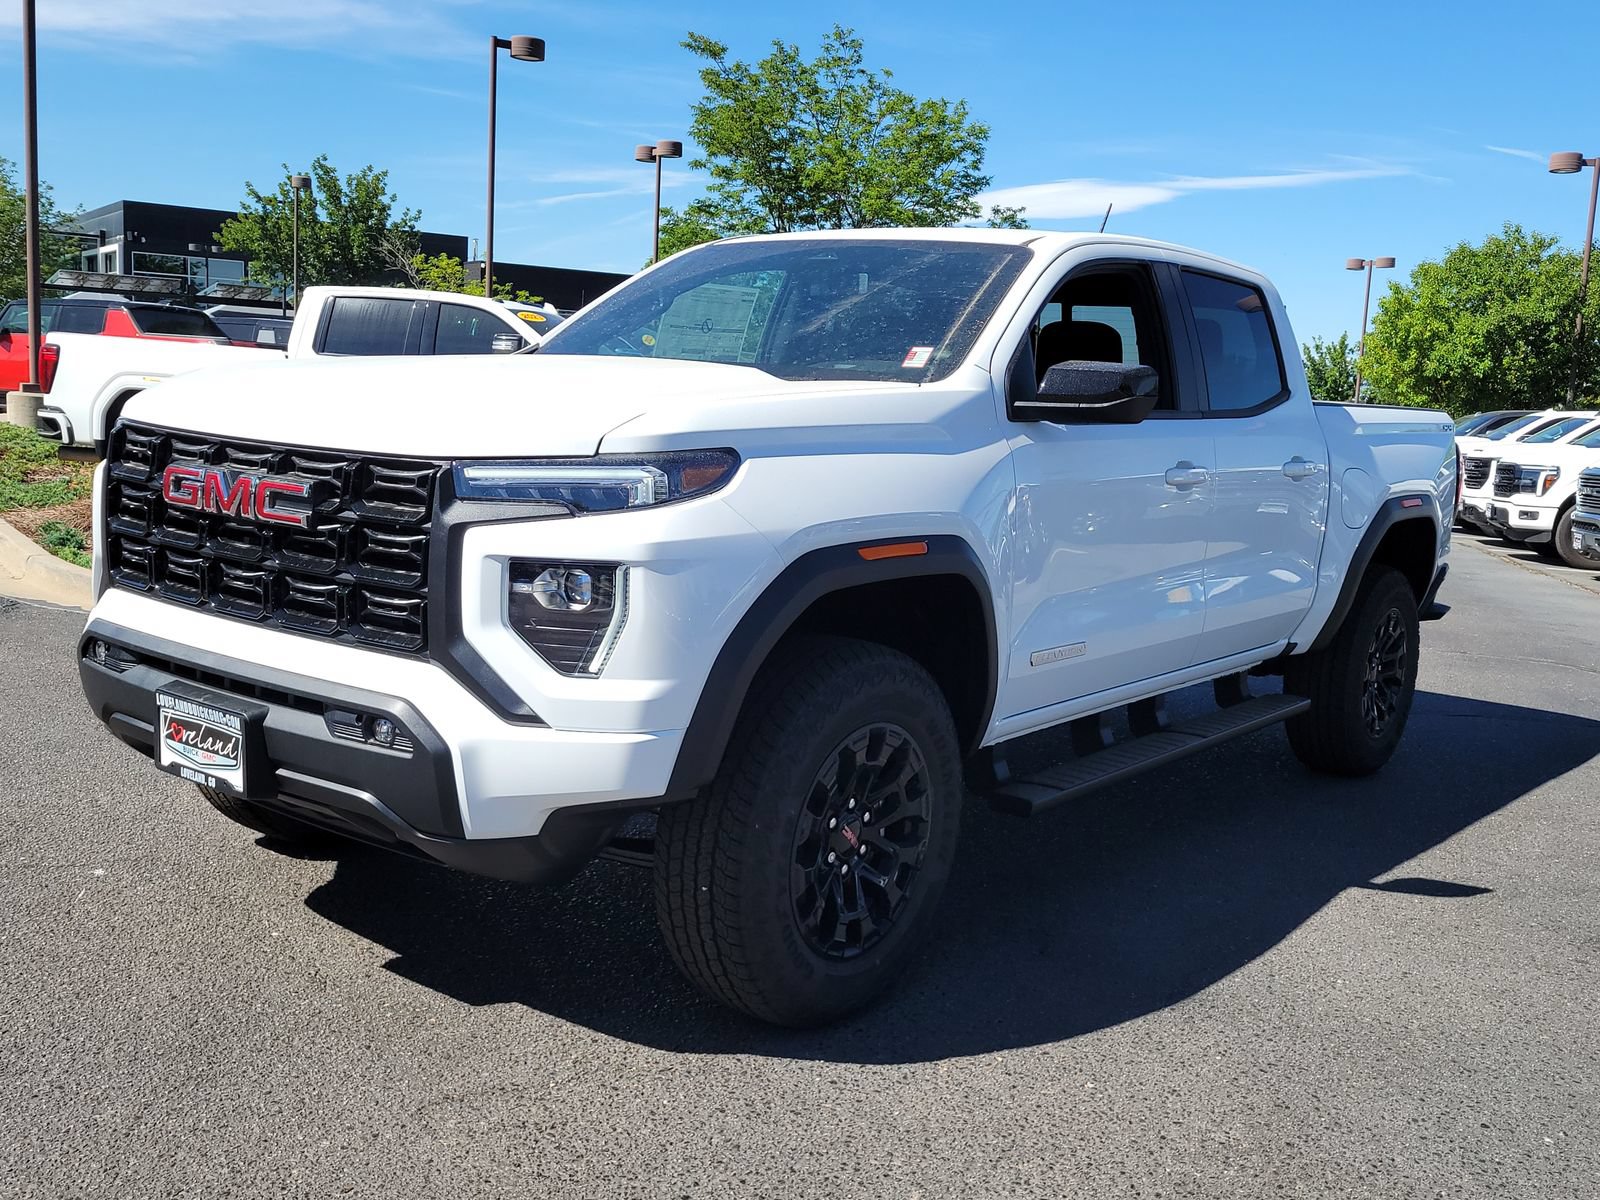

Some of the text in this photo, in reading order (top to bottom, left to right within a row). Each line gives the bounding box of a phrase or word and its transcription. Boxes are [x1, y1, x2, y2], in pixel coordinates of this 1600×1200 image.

[162, 464, 311, 528] GMC
[182, 745, 217, 762] BUICK GMC
